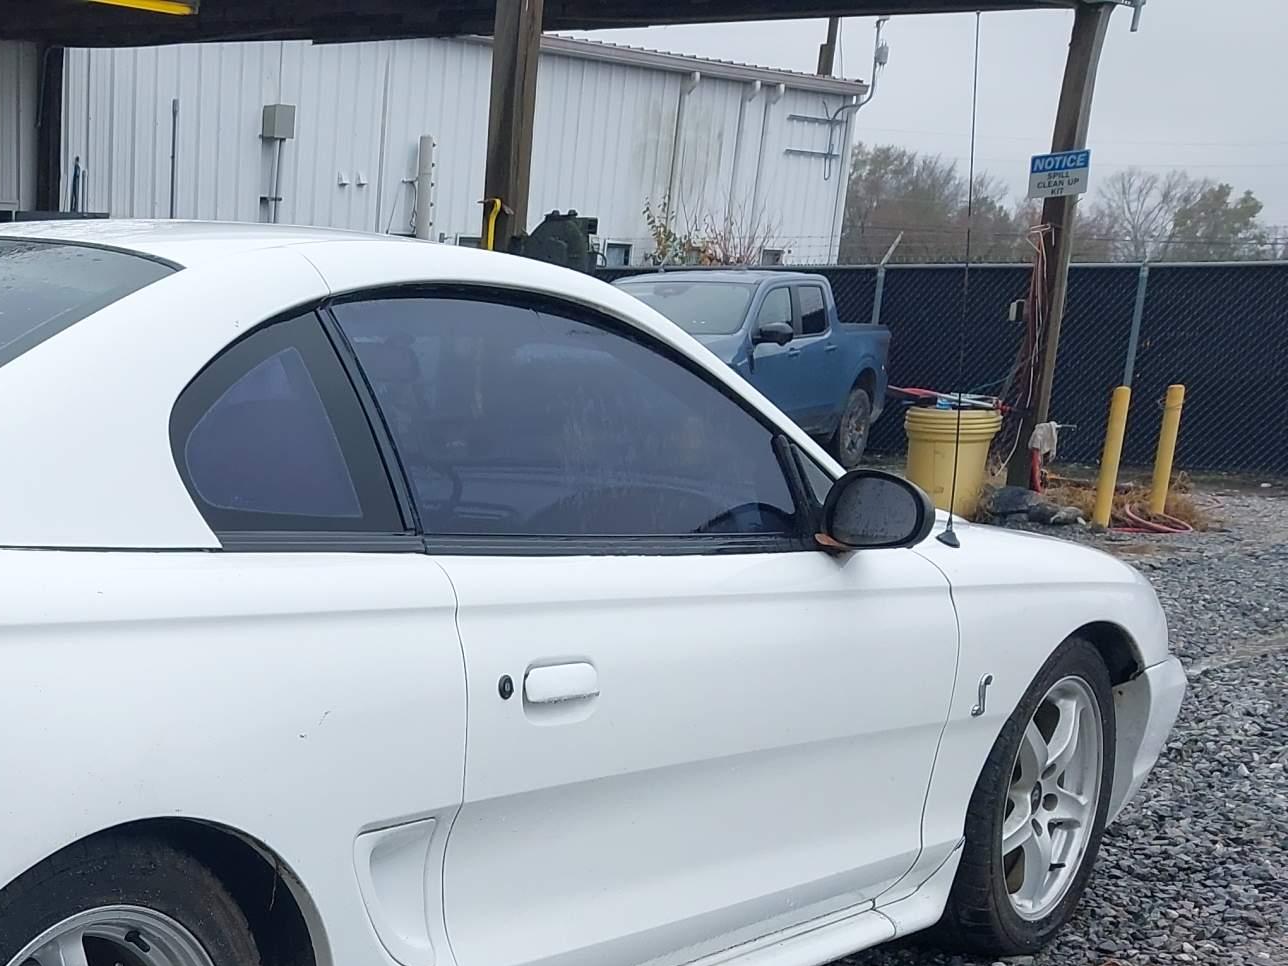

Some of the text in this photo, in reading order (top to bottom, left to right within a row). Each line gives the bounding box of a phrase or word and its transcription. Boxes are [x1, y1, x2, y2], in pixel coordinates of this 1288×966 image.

[1033, 153, 1086, 171] NOTICE
[1047, 171, 1070, 180] SPILL
[1037, 177, 1079, 189] CLEAN UP
